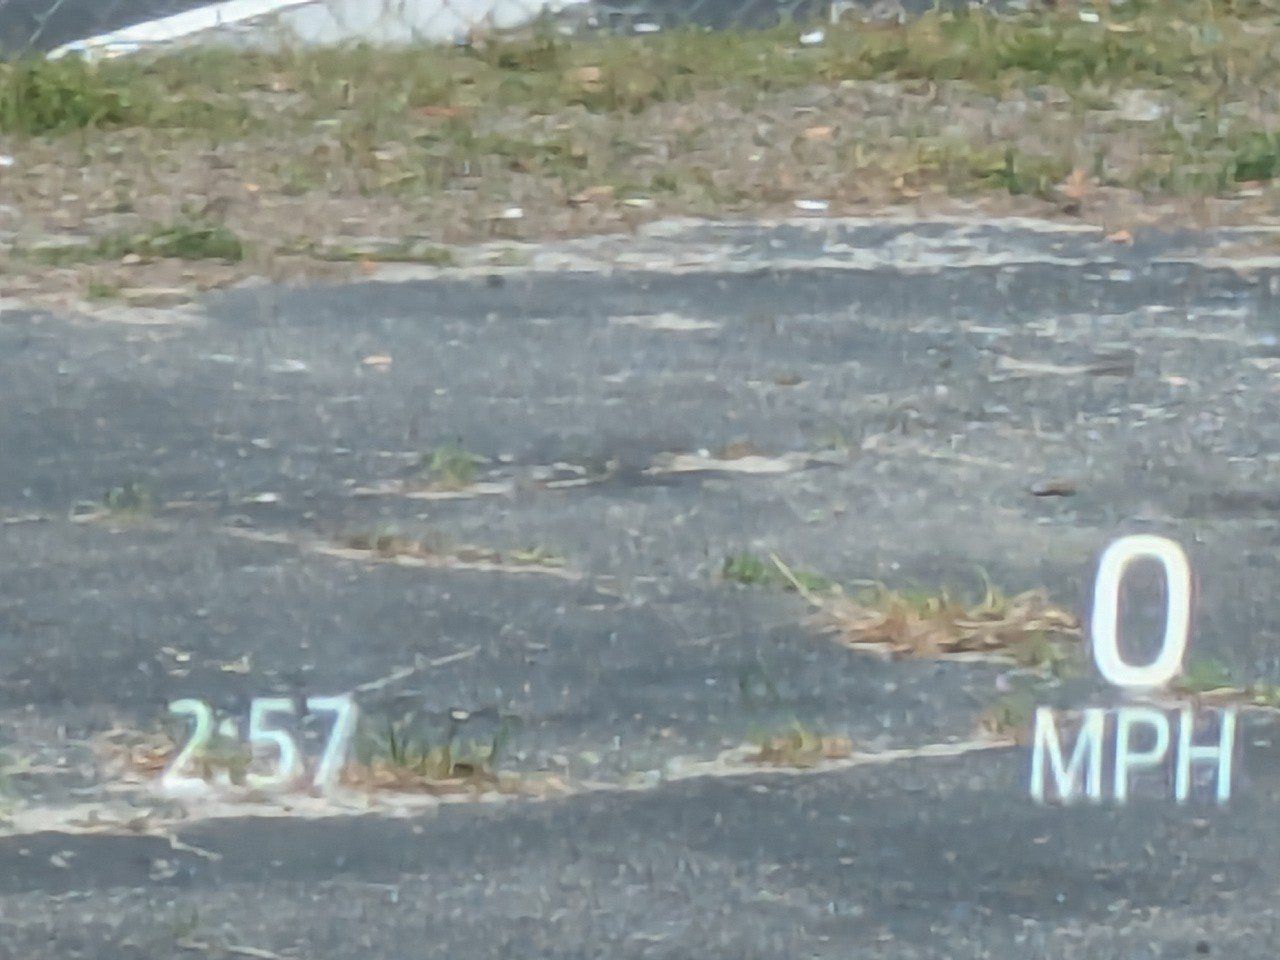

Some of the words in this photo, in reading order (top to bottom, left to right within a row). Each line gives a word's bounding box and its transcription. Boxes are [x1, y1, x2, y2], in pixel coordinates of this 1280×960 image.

[1091, 534, 1191, 688] 0
[161, 697, 358, 796] 2:57
[1030, 706, 1237, 805] MPH
